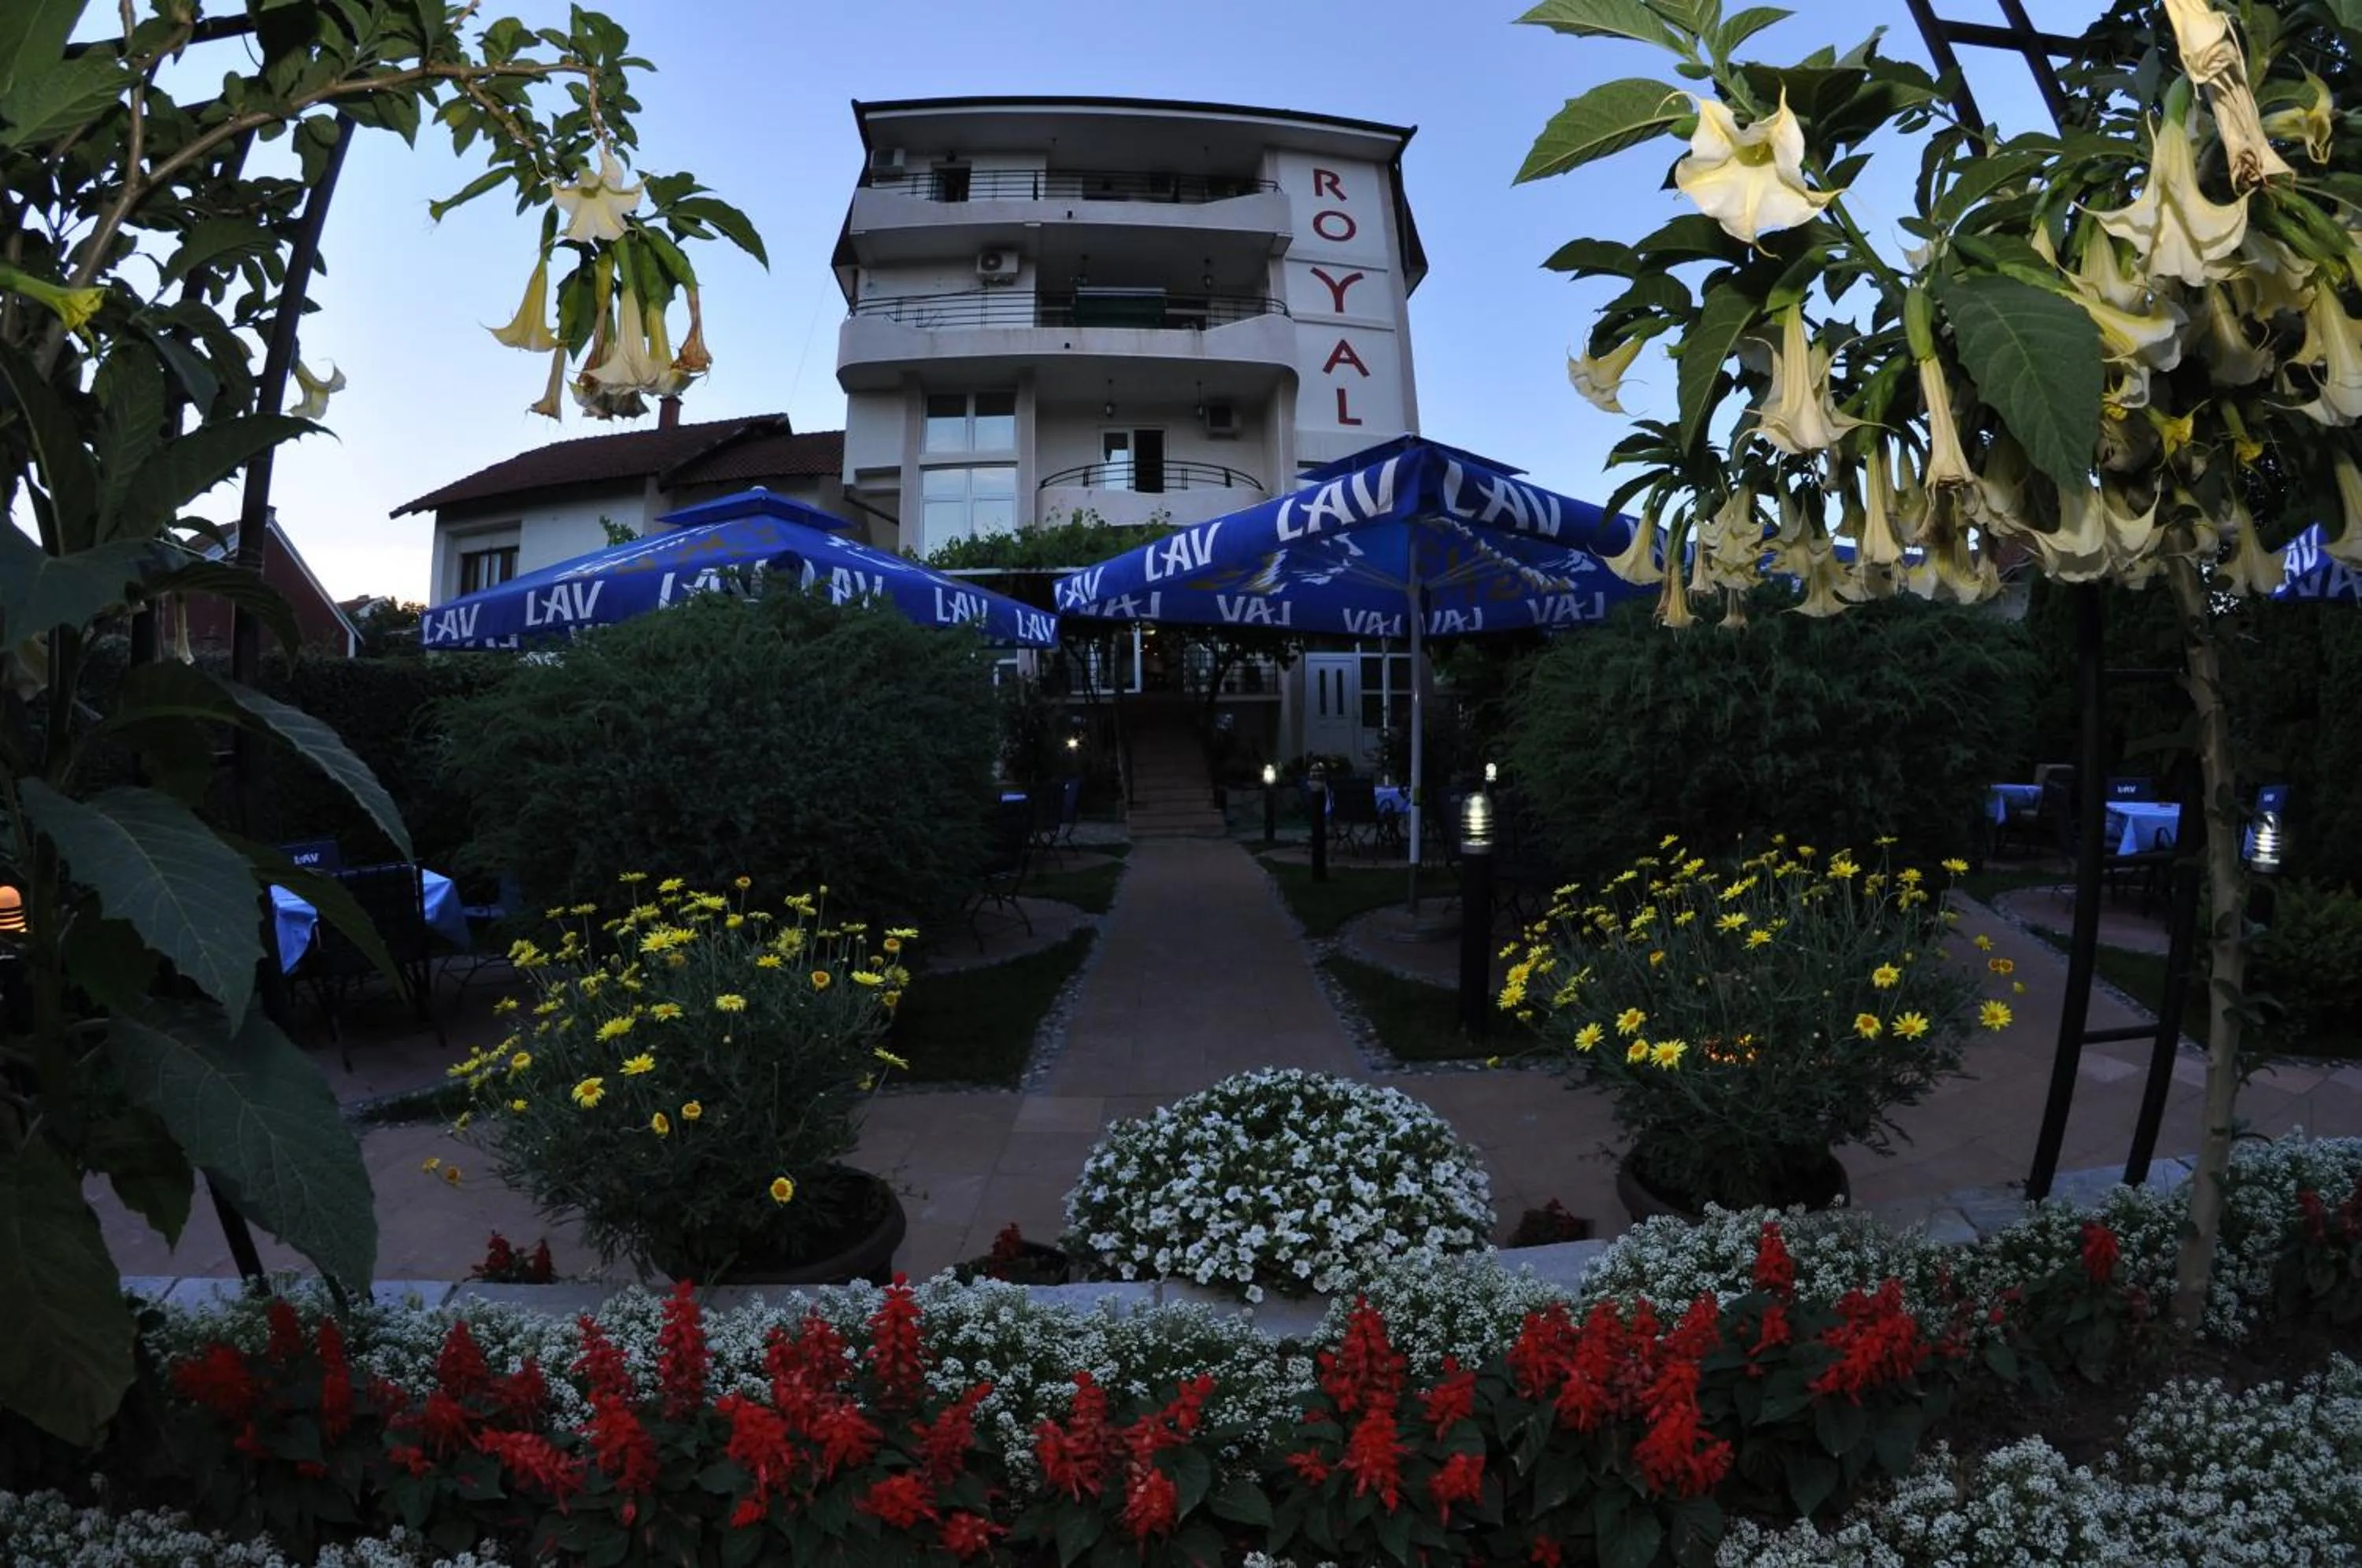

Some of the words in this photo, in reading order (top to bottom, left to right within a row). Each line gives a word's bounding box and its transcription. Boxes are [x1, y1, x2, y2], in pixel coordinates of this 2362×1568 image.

[1310, 168, 1370, 427] ROYAL
[1276, 457, 1400, 542] LAV
[1443, 459, 1561, 538] LAV
[1146, 522, 1222, 582] LAV
[2274, 522, 2319, 594] AV
[526, 580, 605, 627] LAV
[935, 586, 988, 629] LAV
[1053, 566, 1105, 611] LAV
[422, 603, 481, 645] LAV
[1016, 608, 1056, 643] LAV
